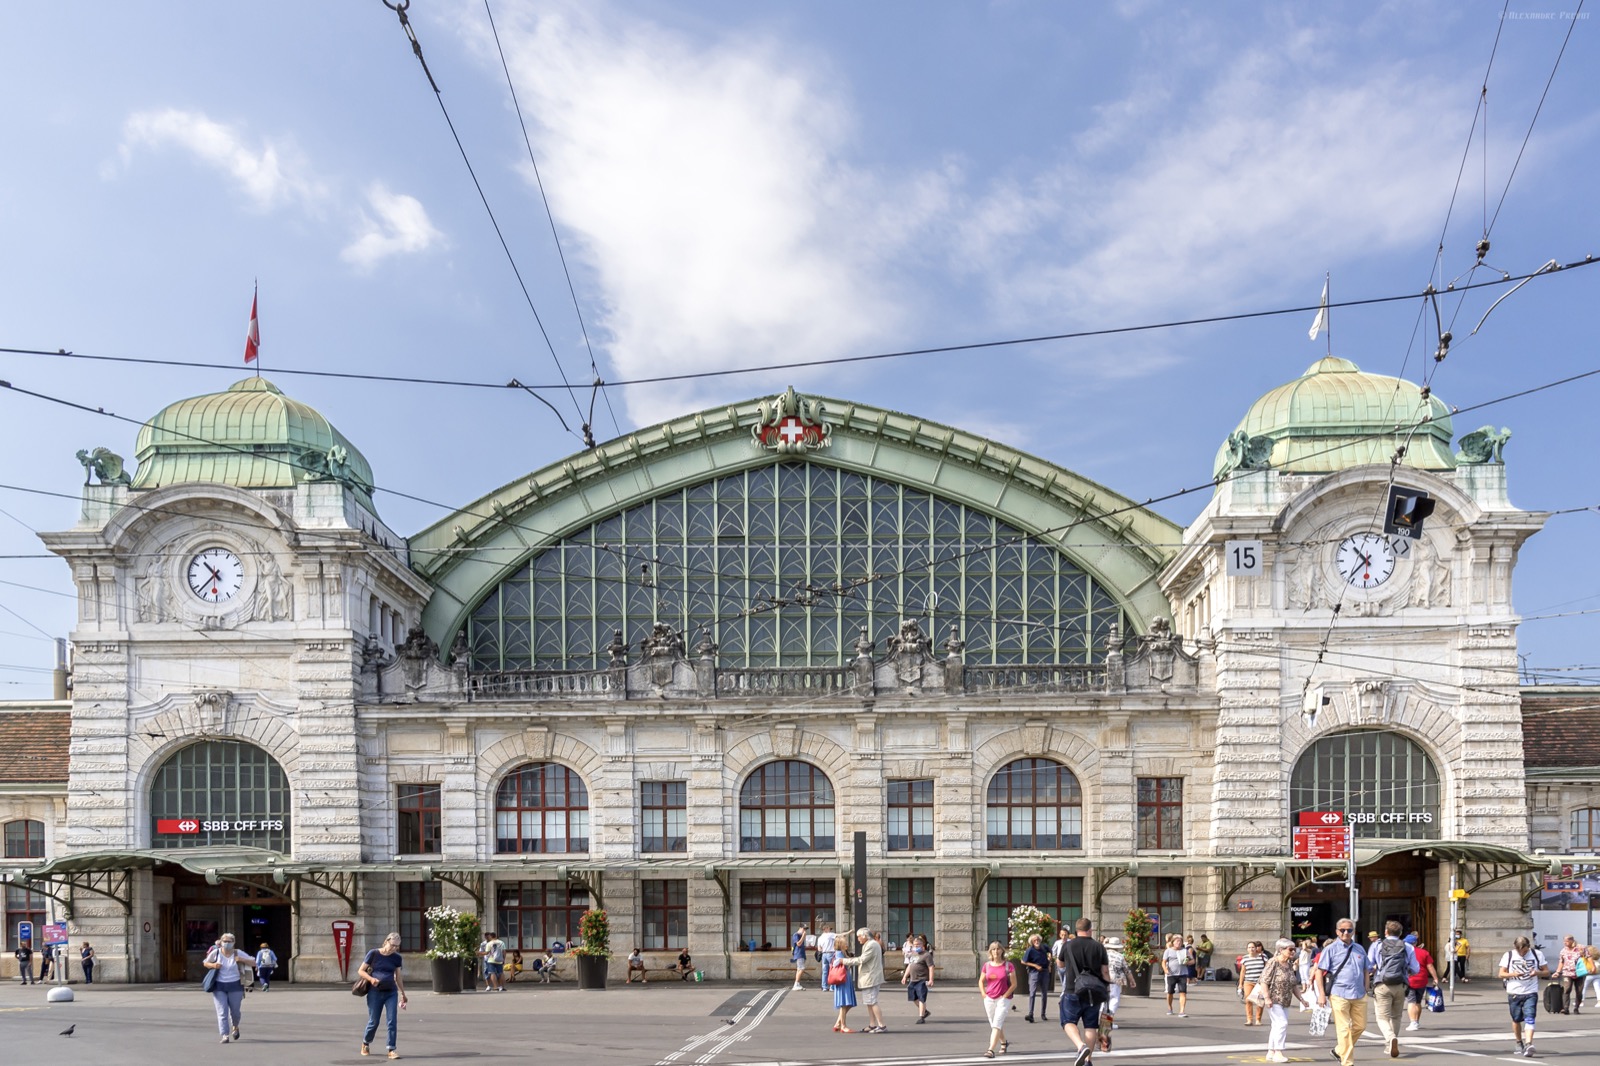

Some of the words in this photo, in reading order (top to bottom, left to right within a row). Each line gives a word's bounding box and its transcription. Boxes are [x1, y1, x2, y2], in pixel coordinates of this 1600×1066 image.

[1397, 527, 1411, 537] 190
[1233, 547, 1256, 570] 15
[1347, 812, 1376, 824] SBB
[1381, 813, 1405, 824] CFF
[1409, 813, 1432, 823] FFS
[203, 820, 229, 831] SBB
[234, 820, 257, 831] CFF
[261, 820, 283, 830] FFS
